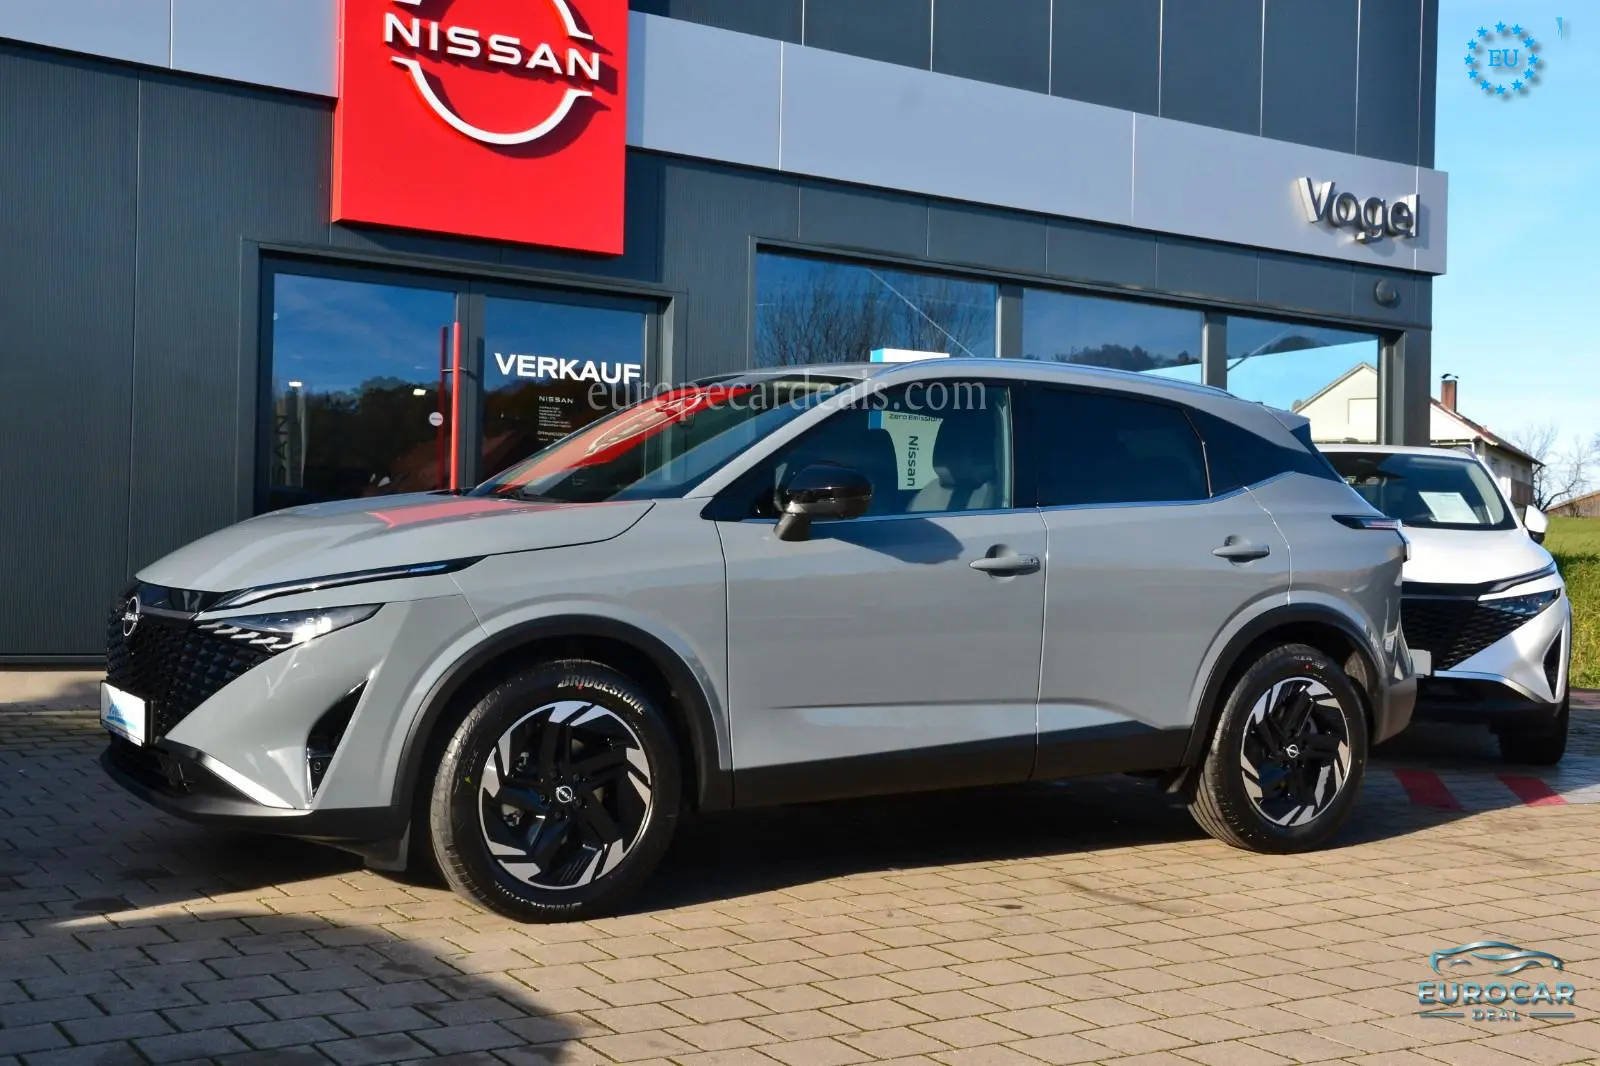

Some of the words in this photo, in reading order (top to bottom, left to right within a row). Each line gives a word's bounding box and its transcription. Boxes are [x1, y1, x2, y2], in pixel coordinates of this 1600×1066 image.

[384, 12, 600, 81] NISSAN
[1297, 176, 1420, 243] Vogel
[494, 352, 641, 385] VERKAUF
[538, 395, 574, 404] NISSAN
[907, 435, 919, 487] Nissan
